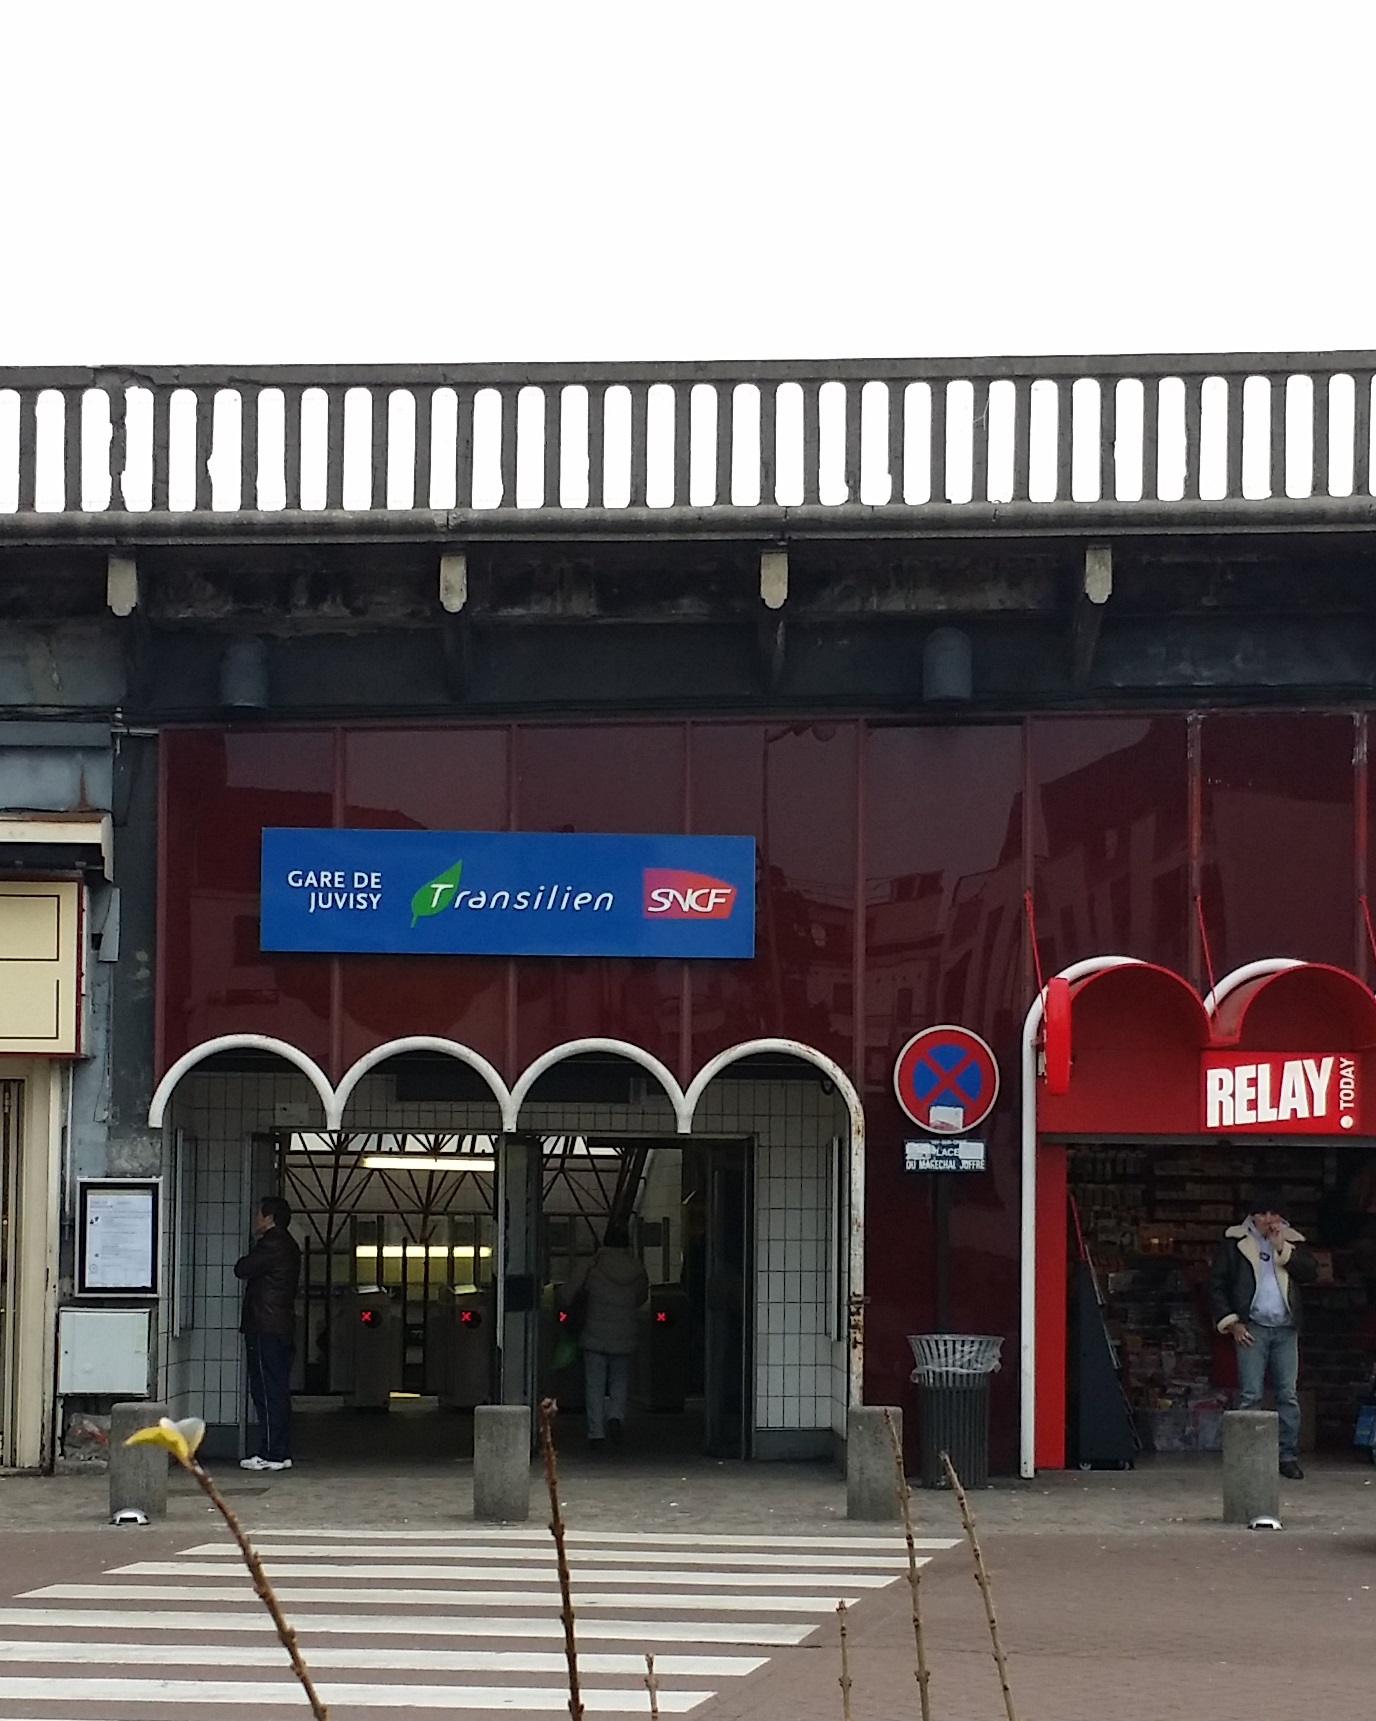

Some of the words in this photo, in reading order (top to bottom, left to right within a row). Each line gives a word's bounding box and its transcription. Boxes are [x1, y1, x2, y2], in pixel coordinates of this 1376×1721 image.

[287, 869, 345, 889] GARE
[354, 871, 382, 890] DE
[308, 891, 382, 914] JUVISY
[428, 882, 615, 912] Transilien
[647, 886, 732, 914] SNCF
[1206, 1056, 1335, 1128] RELAY
[1339, 1057, 1355, 1111] TODAY
[905, 1160, 916, 1170] DU
[960, 1160, 985, 1170] JOFFRE
